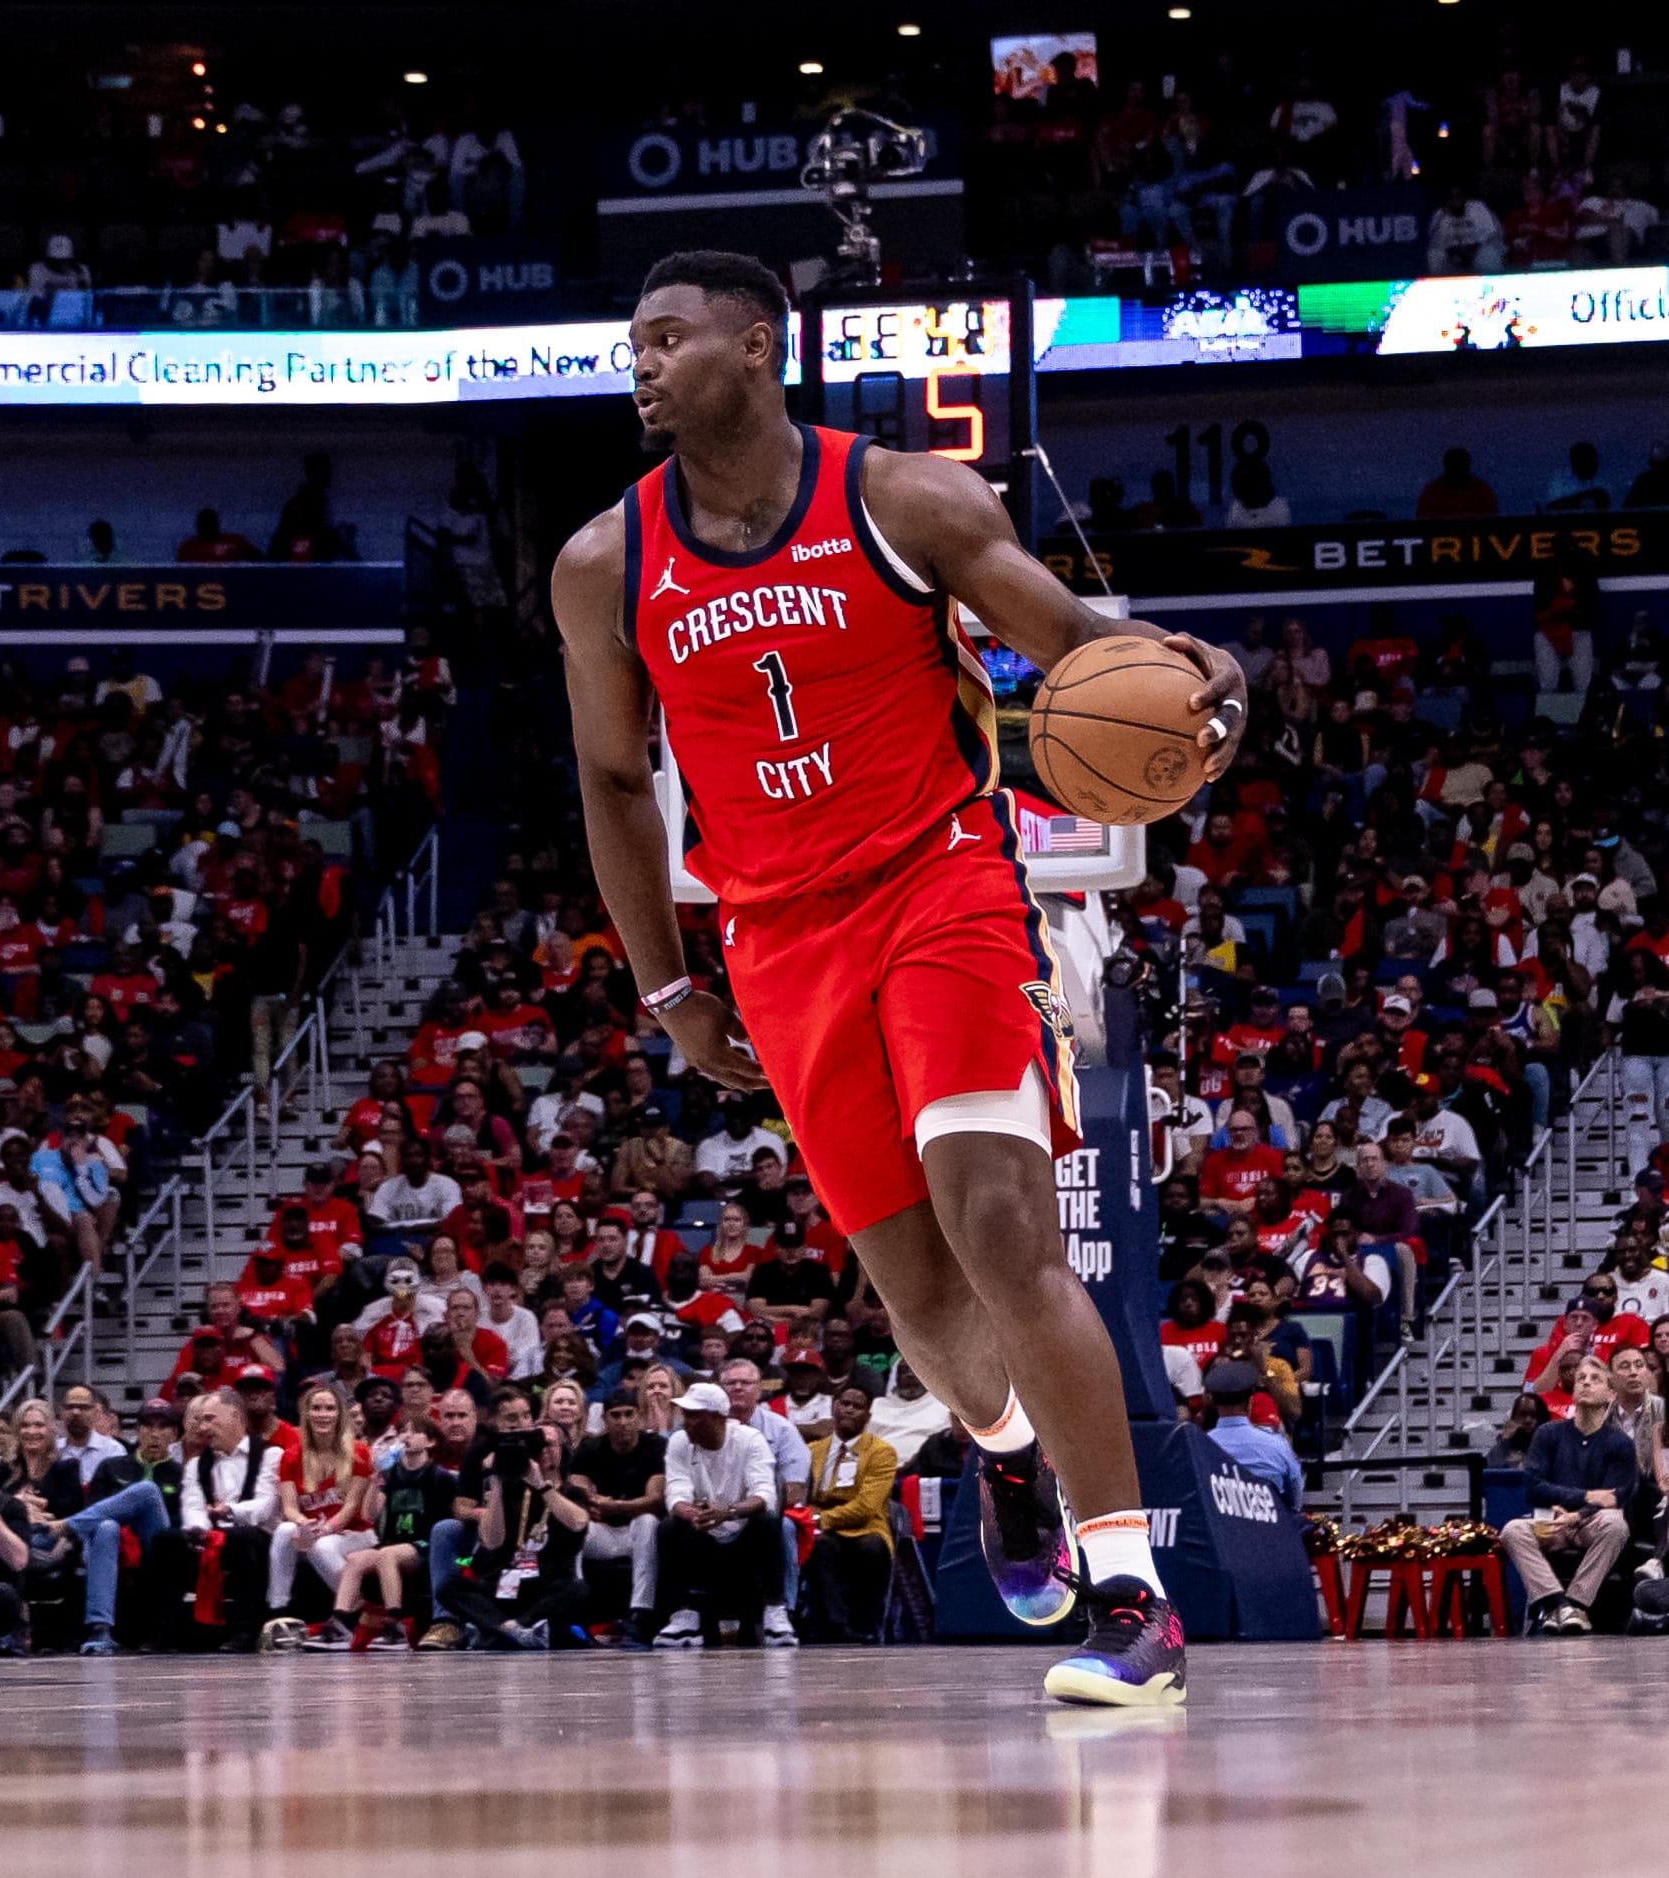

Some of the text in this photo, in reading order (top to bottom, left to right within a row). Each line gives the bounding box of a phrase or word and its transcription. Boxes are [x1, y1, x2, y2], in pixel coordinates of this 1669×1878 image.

[697, 137, 798, 176] HUB
[1339, 216, 1417, 245] HUB
[479, 264, 553, 293] HUB
[128, 351, 277, 392] Cleaning
[287, 351, 415, 384] Partner
[424, 350, 458, 382] of
[467, 348, 518, 380] the
[531, 346, 600, 377] New
[926, 366, 984, 461] 5
[790, 538, 852, 564] ibotta
[667, 584, 850, 665] CRESCENT
[752, 650, 800, 742] 1
[755, 742, 834, 801] CITY
[1054, 1148, 1101, 1189] GET
[1055, 1190, 1102, 1230] THE
[1067, 1233, 1113, 1283] App
[1209, 1462, 1279, 1524] coinbase
